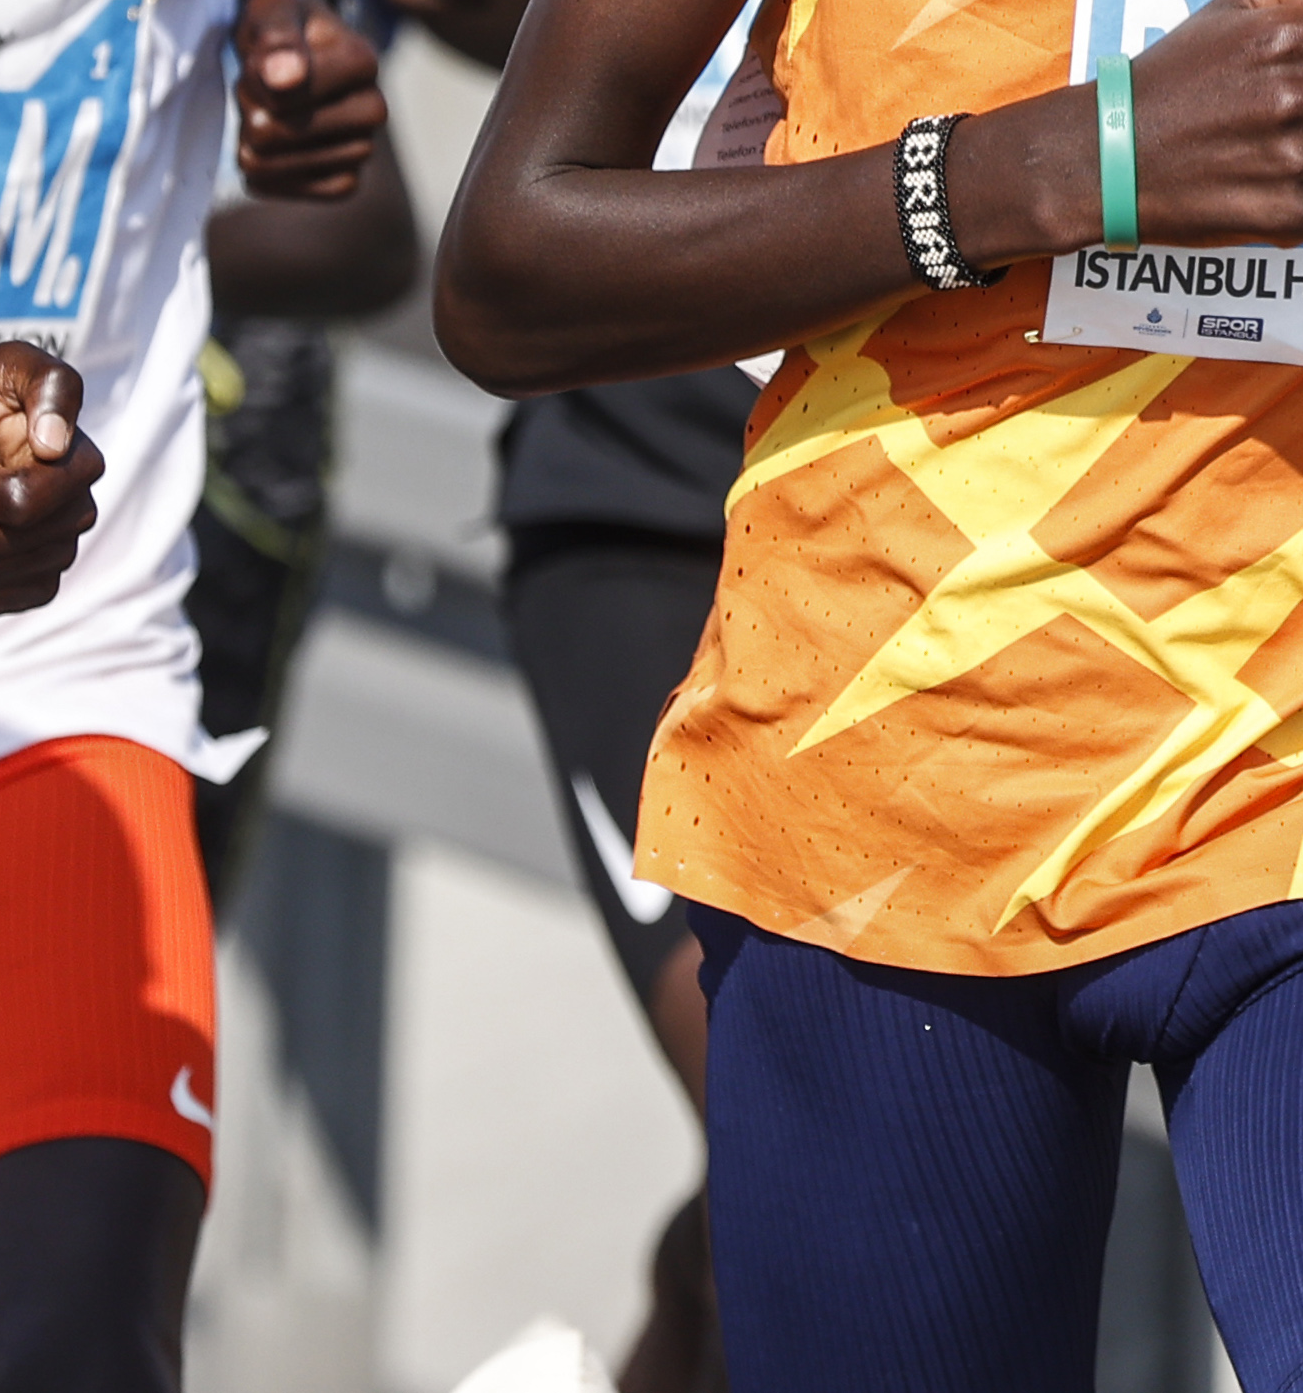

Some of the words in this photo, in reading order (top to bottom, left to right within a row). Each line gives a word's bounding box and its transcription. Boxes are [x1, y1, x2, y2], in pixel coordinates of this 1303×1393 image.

[90, 40, 112, 80] 1
[1075, 249, 1279, 300] ISTANBUL
[1202, 317, 1259, 334] SPOR
